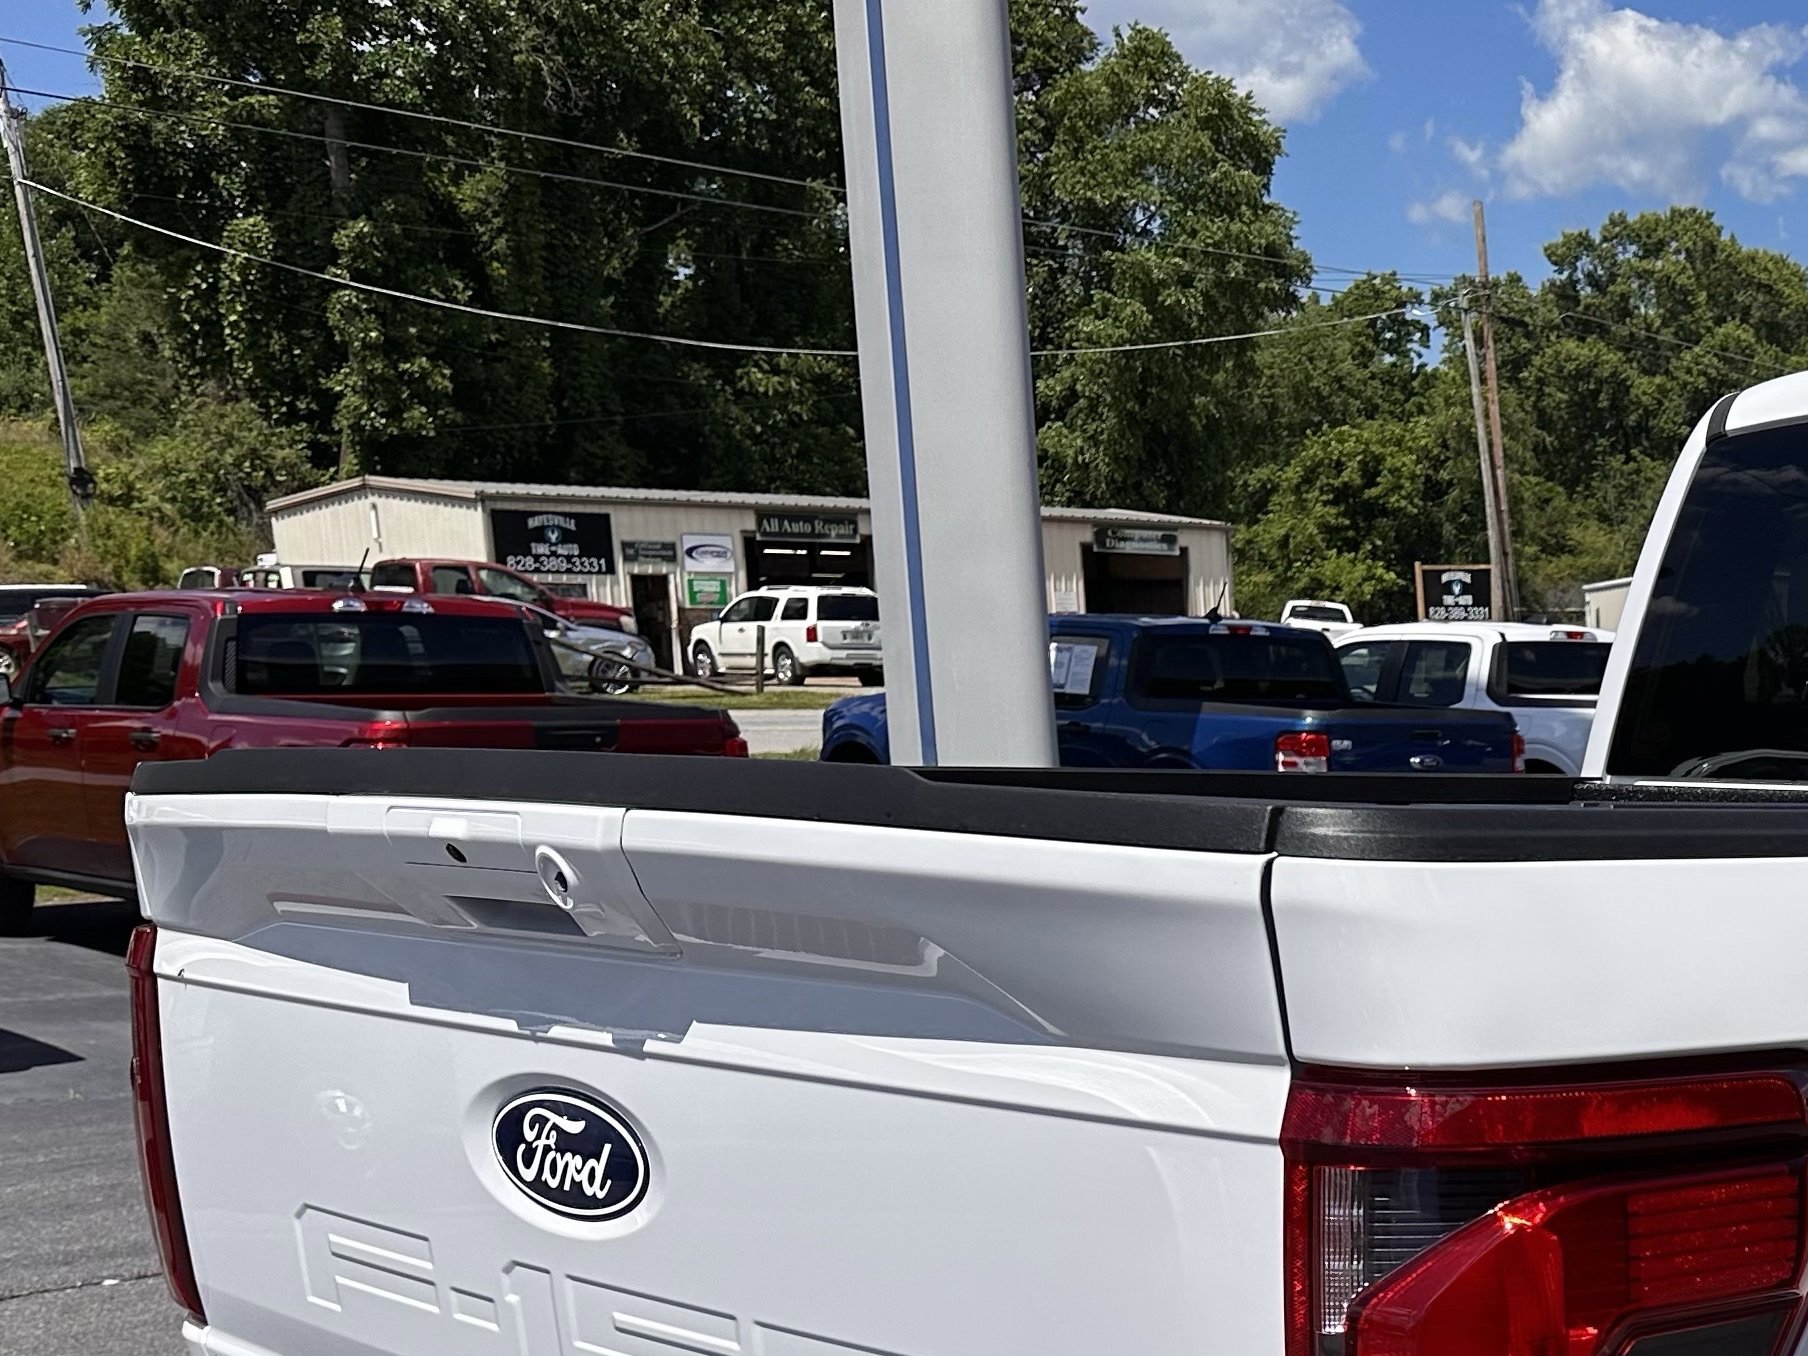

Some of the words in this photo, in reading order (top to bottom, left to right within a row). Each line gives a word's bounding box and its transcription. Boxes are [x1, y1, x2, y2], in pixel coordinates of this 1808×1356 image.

[760, 517, 779, 533] All
[782, 519, 812, 534] Auto
[814, 519, 856, 538] Repair
[506, 555, 607, 573] 828-389-3331
[516, 1106, 613, 1200] Ford
